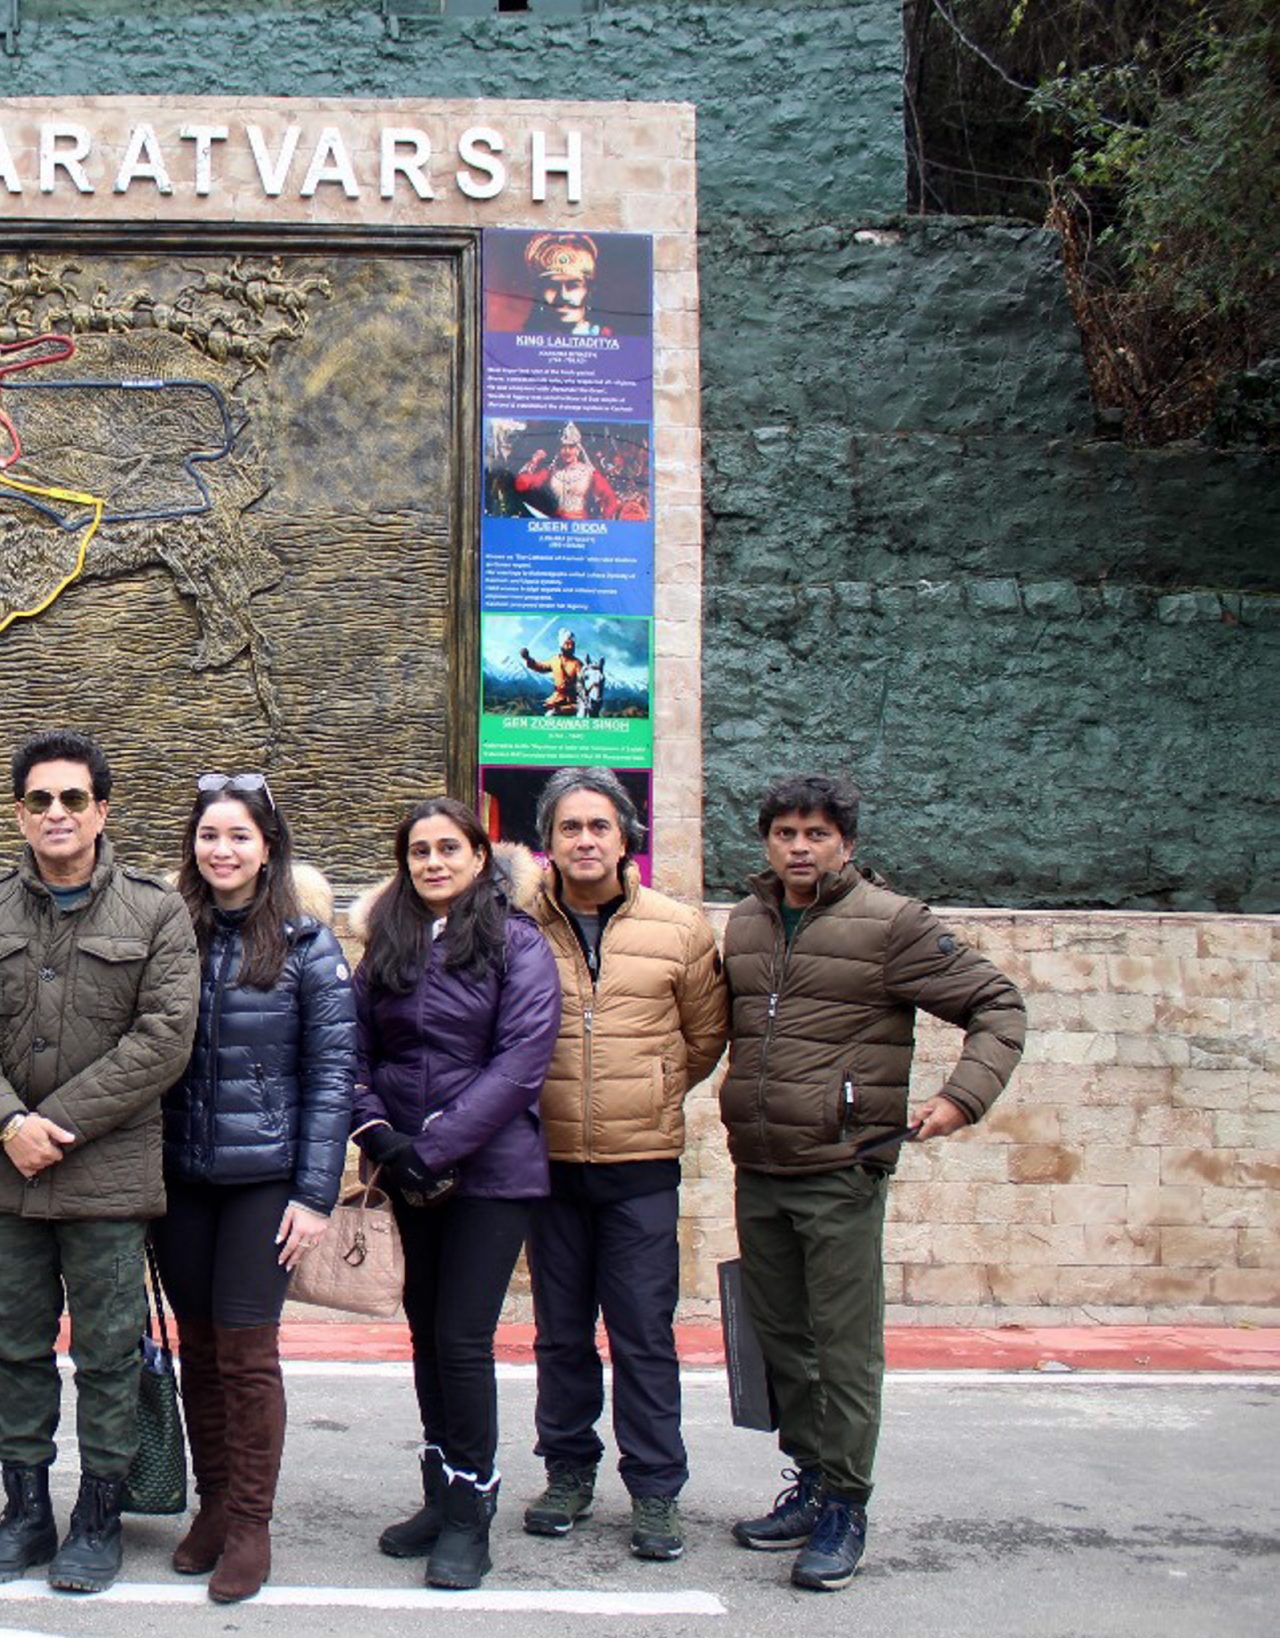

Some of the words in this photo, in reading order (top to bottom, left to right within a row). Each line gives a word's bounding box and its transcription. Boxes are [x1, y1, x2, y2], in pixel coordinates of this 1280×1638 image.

[516, 335, 544, 347] KING
[547, 336, 620, 350] LALITADITYA
[528, 521, 569, 532] QUEEN
[571, 522, 608, 534] DIDDA
[503, 717, 528, 729] GEN
[592, 718, 630, 733] SINGH
